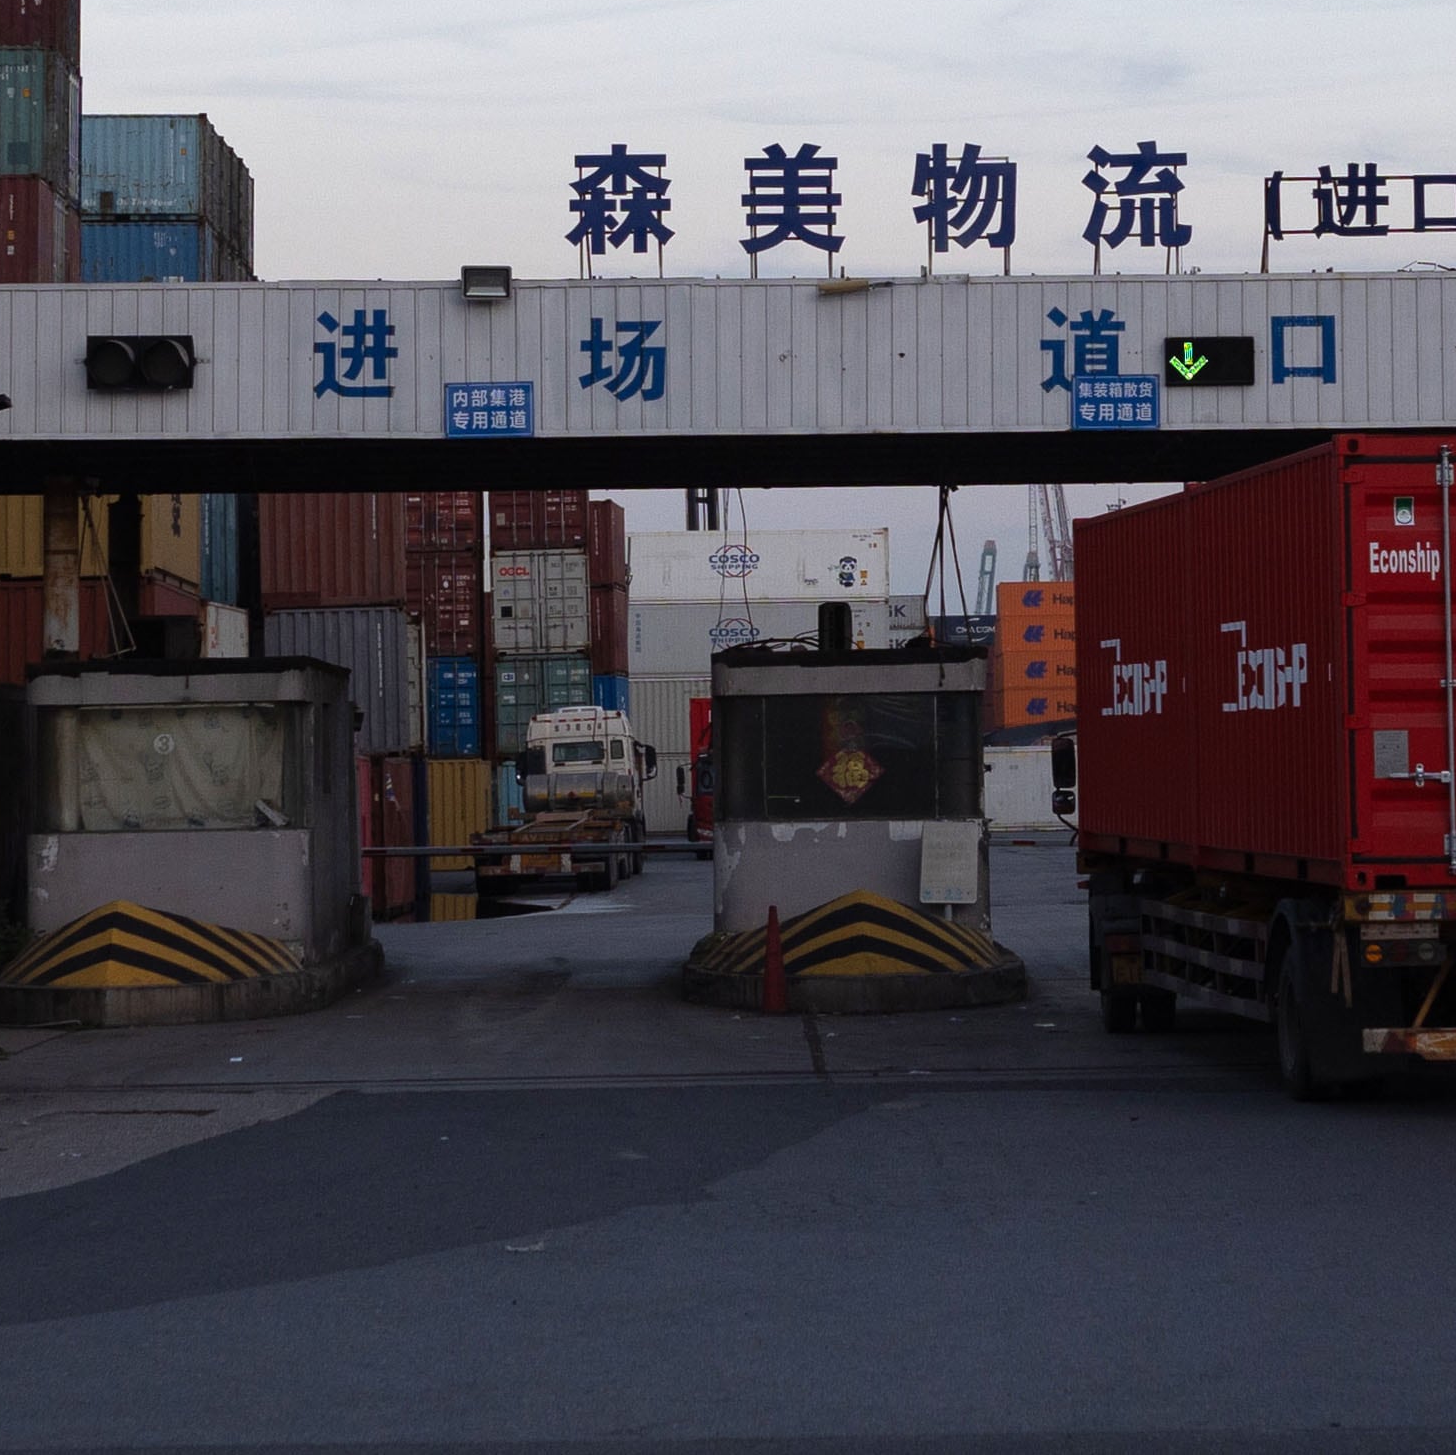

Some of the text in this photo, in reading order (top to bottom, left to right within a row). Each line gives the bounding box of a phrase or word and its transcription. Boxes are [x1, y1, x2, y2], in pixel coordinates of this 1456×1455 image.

[566, 141, 1192, 255] 森美物流
[451, 389, 527, 409] 内部集港
[1078, 380, 1153, 400] 集装箱散货
[451, 410, 528, 431] 专用通道
[1079, 402, 1153, 423] 专用通道
[709, 554, 760, 563] COSCO
[1369, 541, 1441, 581] Econship
[709, 627, 760, 637] COSCO
